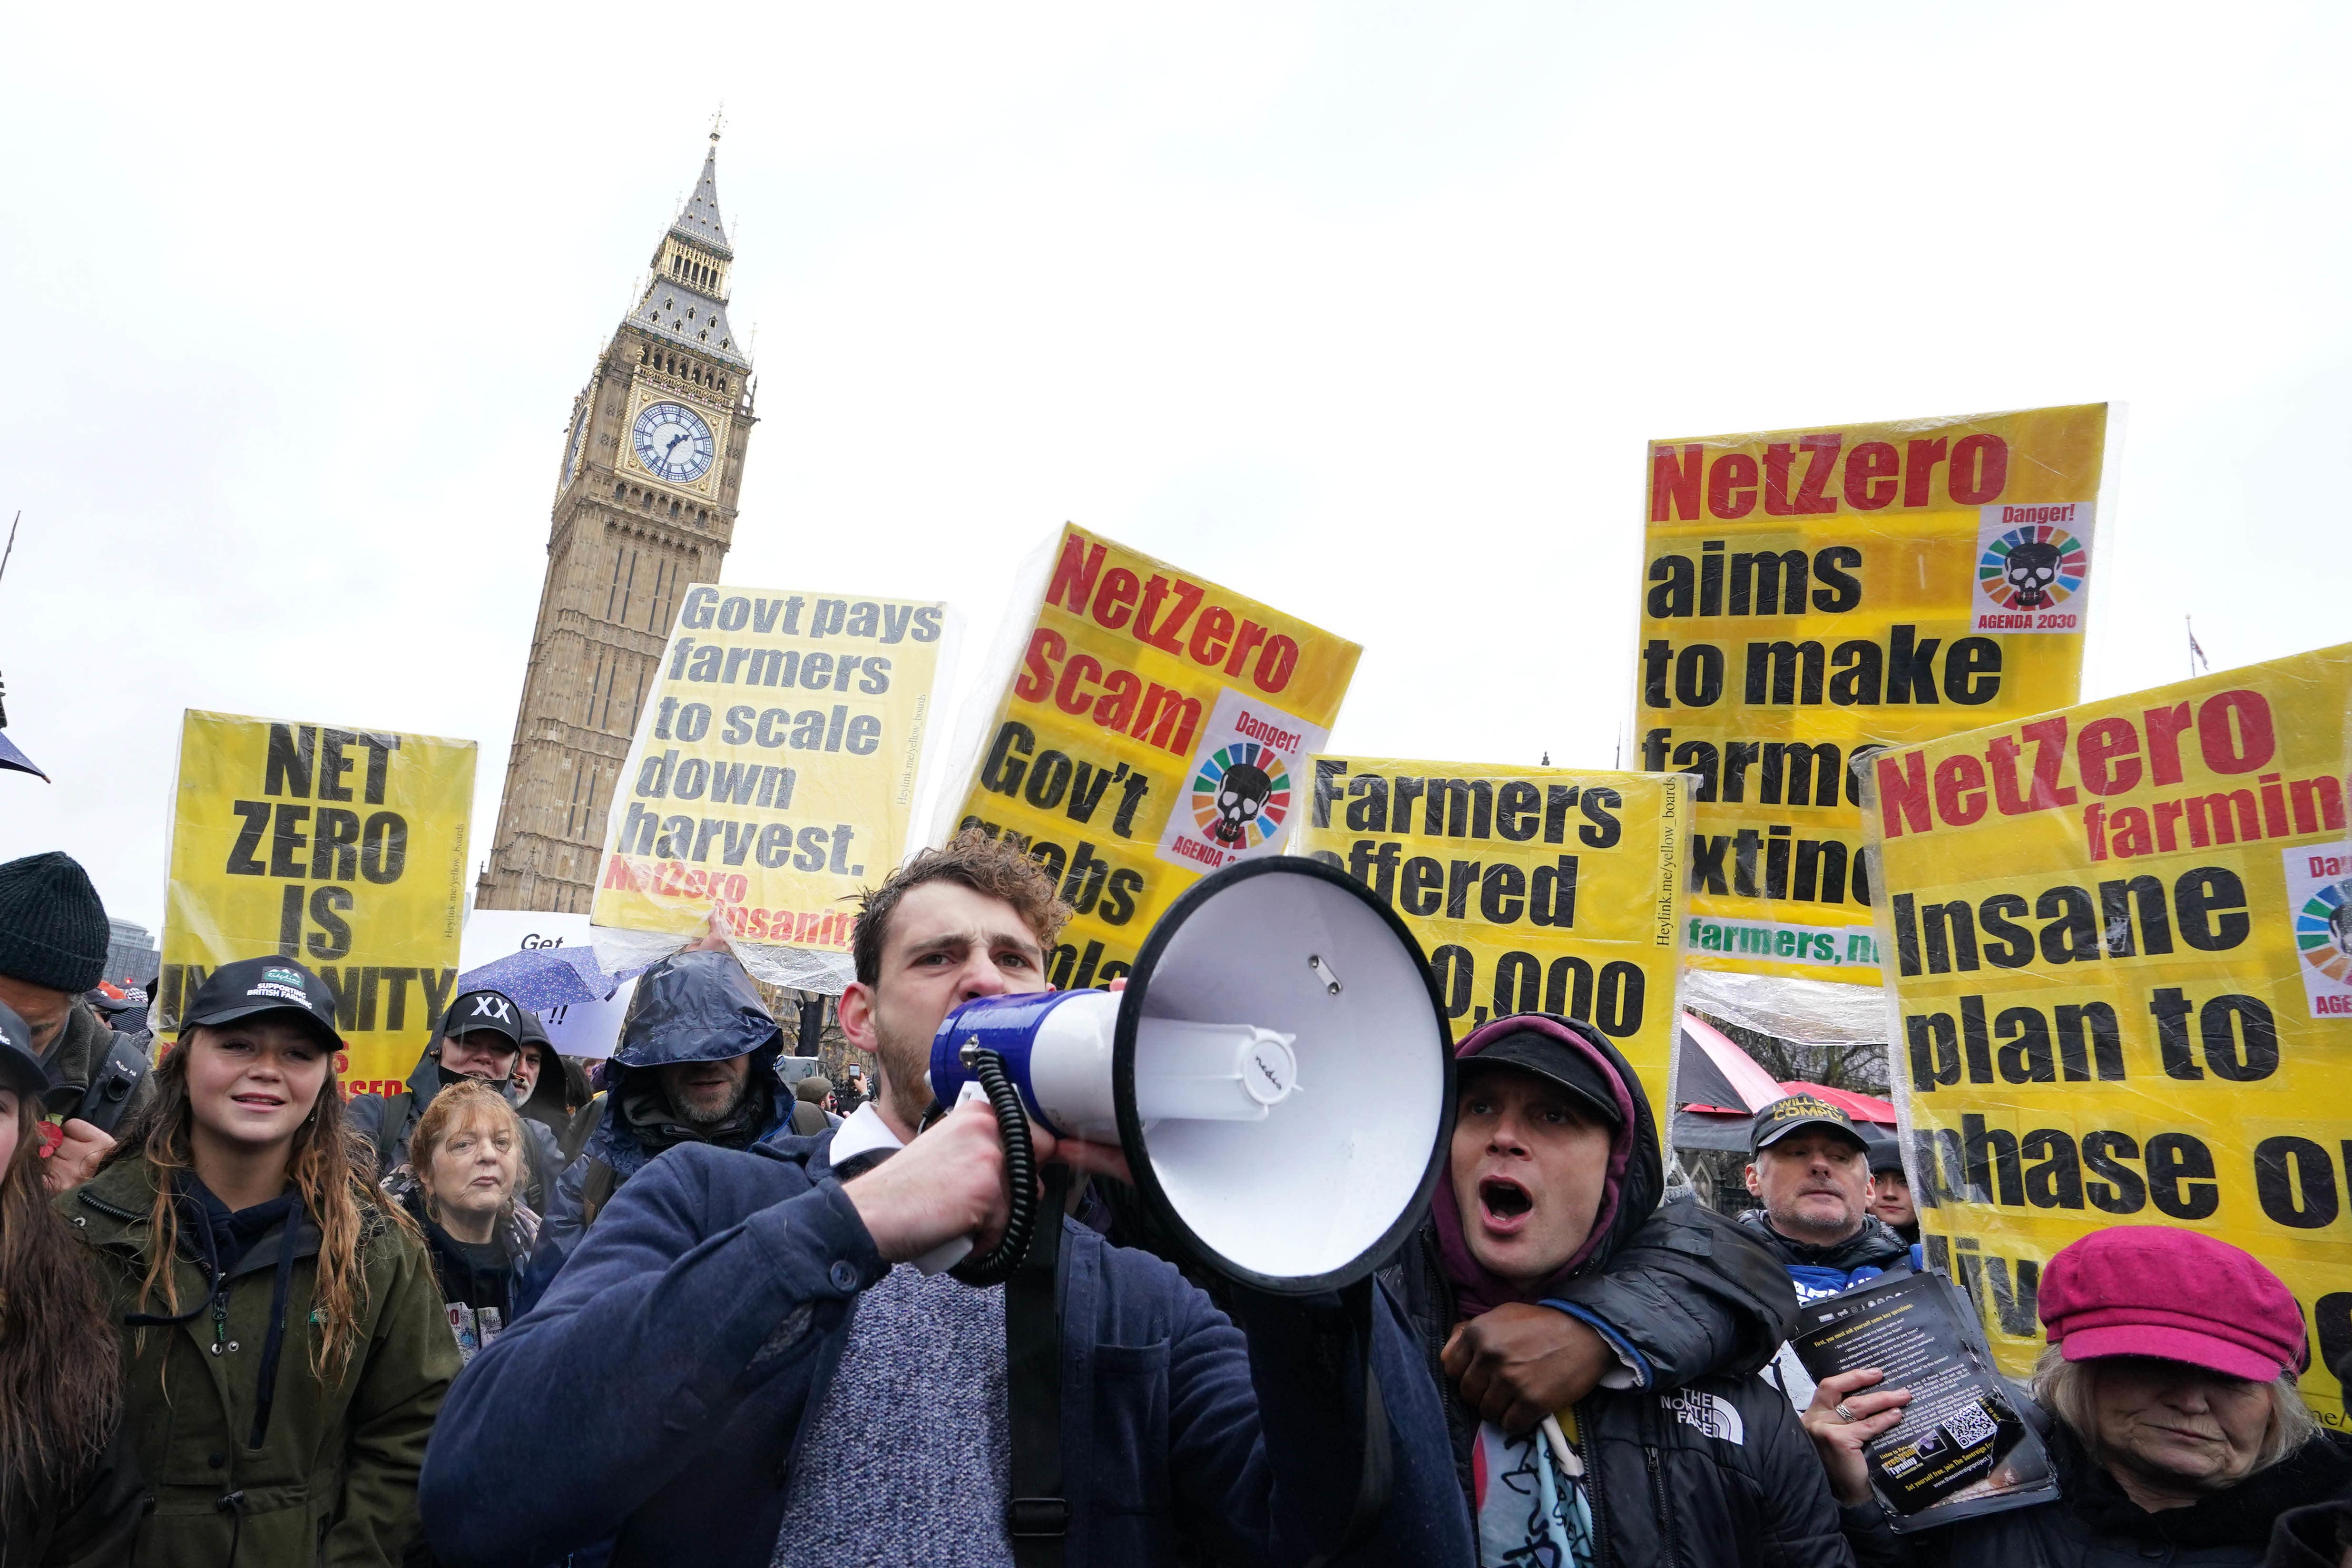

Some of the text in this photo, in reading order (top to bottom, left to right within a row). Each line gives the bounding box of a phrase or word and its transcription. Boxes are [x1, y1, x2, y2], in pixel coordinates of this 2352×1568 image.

[1651, 433, 2008, 522] NetZero
[2003, 504, 2075, 524] Danger!
[1647, 540, 1862, 619] aims
[681, 588, 942, 644] Govt pays
[1045, 533, 1298, 693] NetZero
[1979, 614, 2077, 628] AGENDA 2030
[668, 637, 892, 695] farmers
[1015, 627, 1201, 756] Scam
[1643, 624, 2002, 708] to make
[655, 696, 882, 755] to scale
[1235, 710, 1301, 755] Danger!
[264, 723, 401, 804] NET
[635, 749, 796, 809] down
[1877, 689, 2275, 839] NetZero
[1312, 760, 1622, 849] Farmers
[2084, 773, 2352, 862] farmin
[226, 800, 408, 884] ZERO
[617, 803, 864, 877] harvest.
[1172, 835, 1224, 868] AGENDA
[1656, 776, 1676, 947] Heylink.me/yellow_boards
[1690, 825, 1872, 908] xtin
[604, 855, 748, 903] NetZero
[960, 815, 1144, 926] abs
[279, 885, 353, 960] IS
[521, 933, 563, 950] Get
[1688, 918, 1841, 966] farmers,
[1892, 867, 2250, 977] Insane
[160, 964, 458, 1032] INITY
[257, 983, 306, 999] SUPPORTING
[281, 991, 312, 1009] FARMING
[471, 997, 511, 1024] XX
[1431, 945, 1645, 1038] 0,000
[2316, 995, 2352, 1014] AGE
[1906, 988, 2279, 1092] plan to
[1774, 1106, 1843, 1124] COMPLY
[1779, 1097, 1813, 1109] WILL
[1814, 1098, 1840, 1113] NOT
[1912, 1113, 2352, 1229] phase o
[1852, 1320, 1872, 1331] yourself
[1660, 1395, 1712, 1422] NORTH
[1677, 1411, 1713, 1438] FACE
[1680, 1388, 1712, 1408] THE
[1888, 1456, 1918, 1476] Tyranny
[1904, 1483, 1915, 1491] Set
[1912, 1473, 1935, 1488] yourself
[1942, 1462, 1956, 1472] join
[1952, 1457, 1964, 1465] The
[1960, 1445, 1988, 1461] Sovereign
